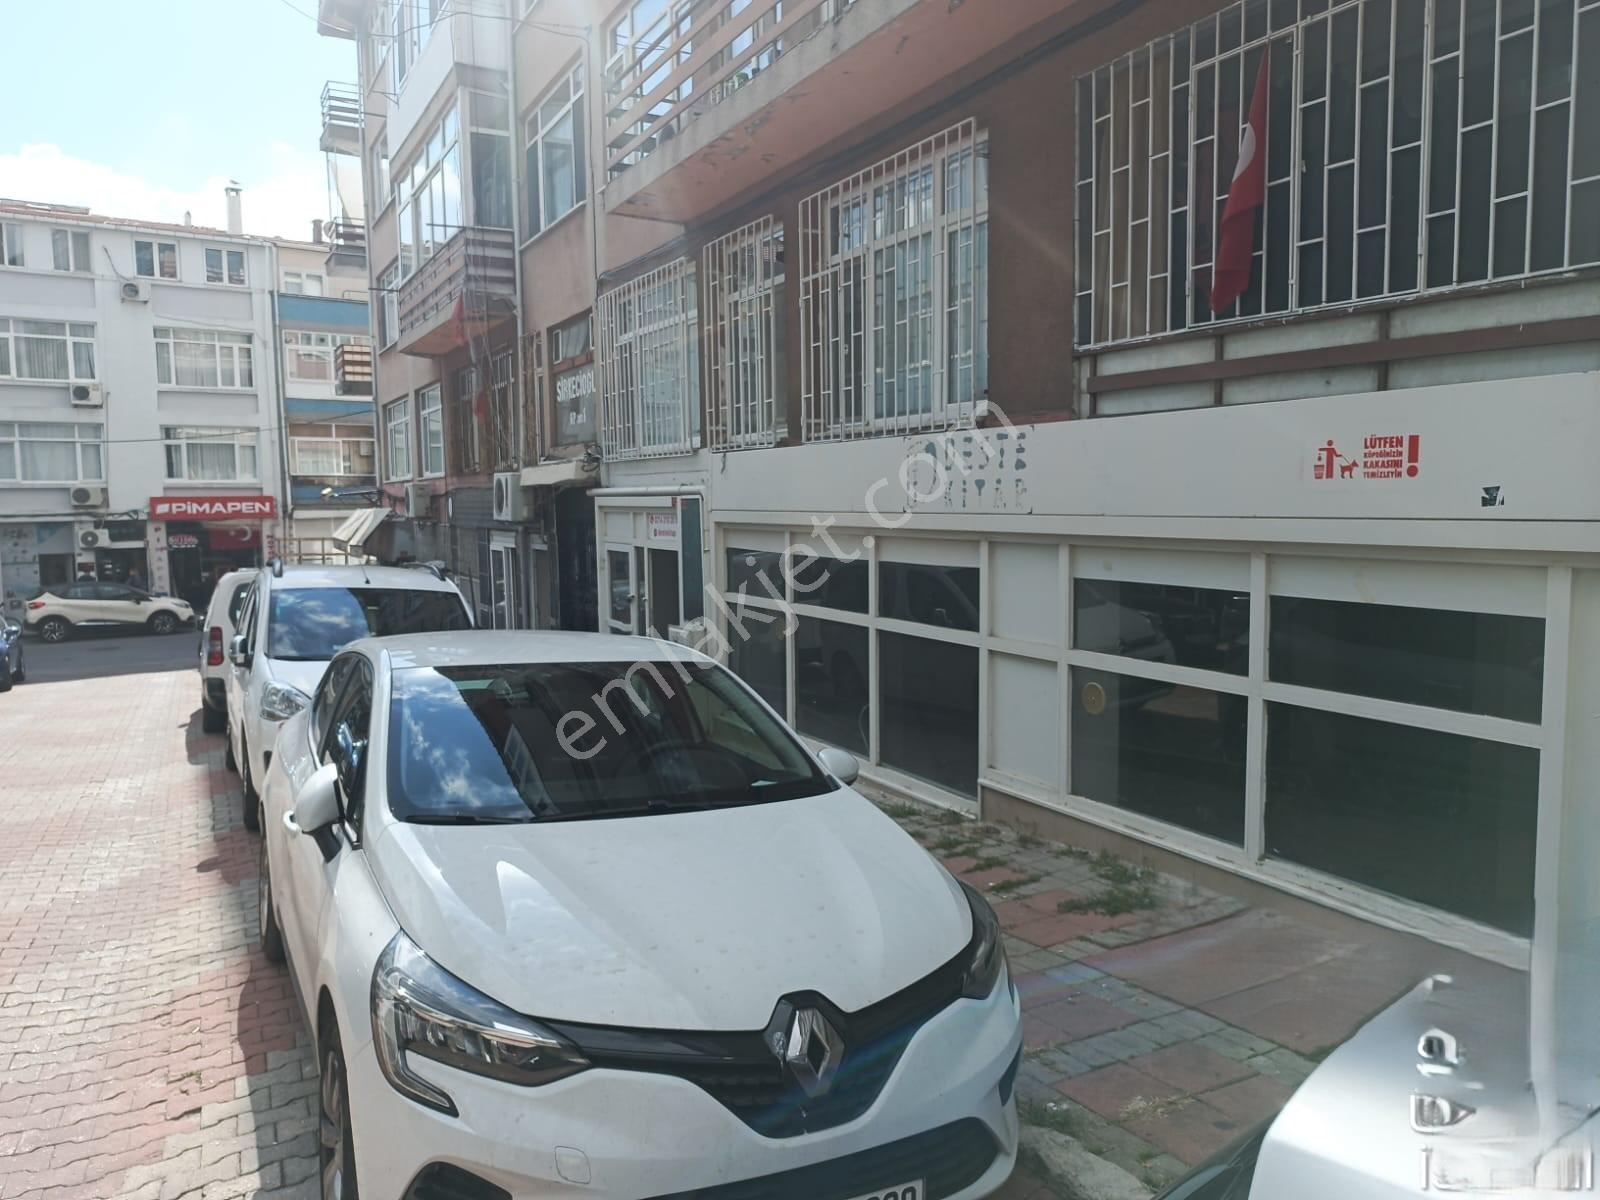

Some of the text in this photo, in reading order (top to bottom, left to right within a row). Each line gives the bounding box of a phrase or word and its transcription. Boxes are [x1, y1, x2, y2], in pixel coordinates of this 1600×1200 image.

[557, 370, 596, 402] SİRKECİOĞL
[1364, 434, 1403, 449] LÜTFEN
[1363, 459, 1402, 469] KAKASINI
